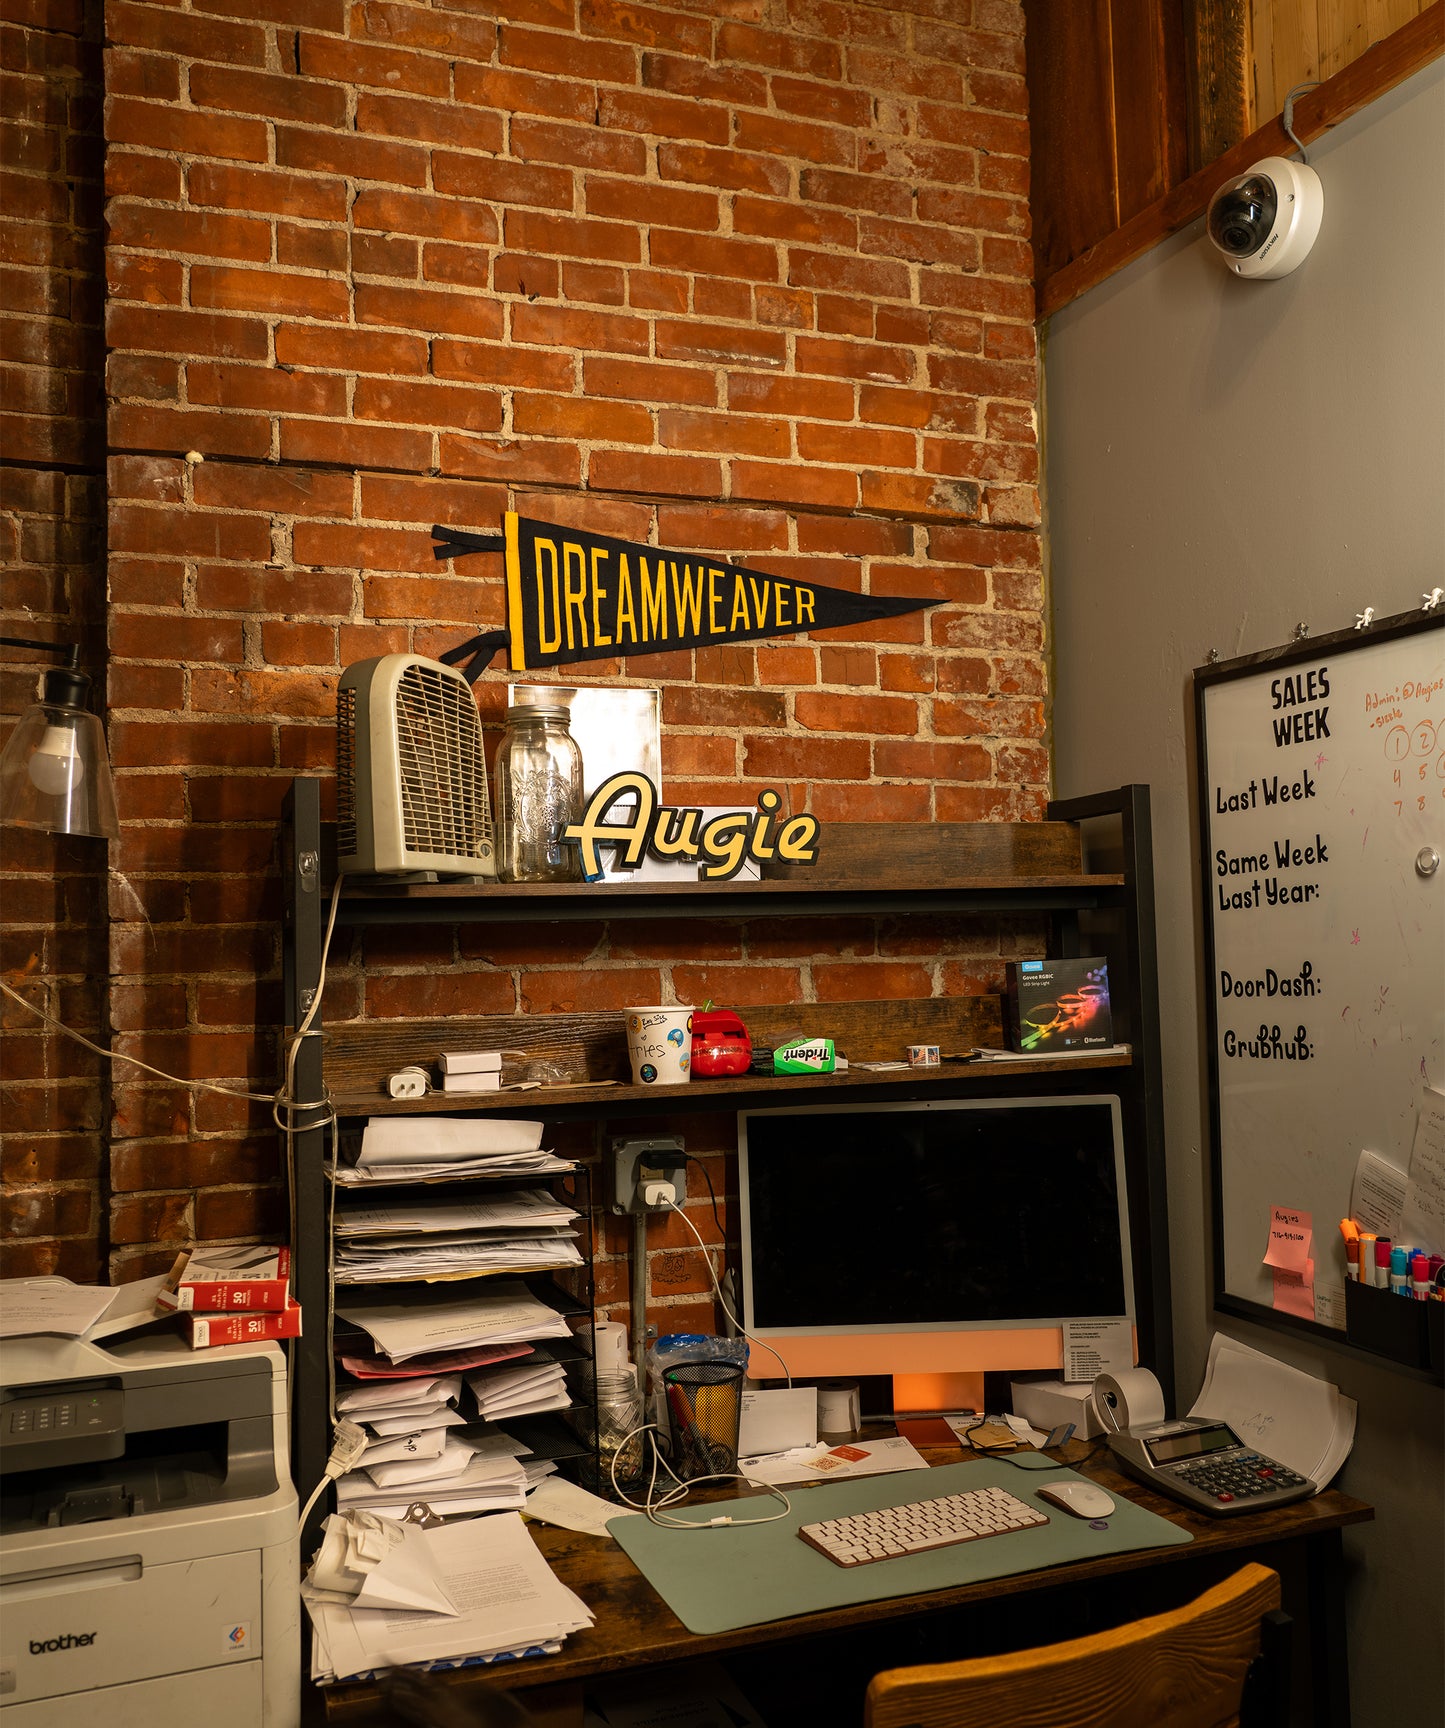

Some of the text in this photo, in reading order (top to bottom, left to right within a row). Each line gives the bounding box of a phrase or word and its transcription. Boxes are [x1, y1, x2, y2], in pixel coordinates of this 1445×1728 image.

[533, 536, 816, 654] DREAMWEAVER
[1271, 667, 1330, 710] SALES
[1273, 707, 1331, 748] WEEK
[1216, 769, 1316, 814] Last Week
[562, 771, 819, 880] Augie
[1216, 834, 1329, 877] Same Week
[1218, 877, 1320, 911] Last Year:
[1220, 960, 1322, 998] DoorDash:
[784, 1048, 830, 1062] Trident
[1223, 1024, 1316, 1061] Grubhub:
[233, 1291, 242, 1304] 50
[248, 1320, 257, 1333] 50
[29, 1631, 97, 1656] brother
